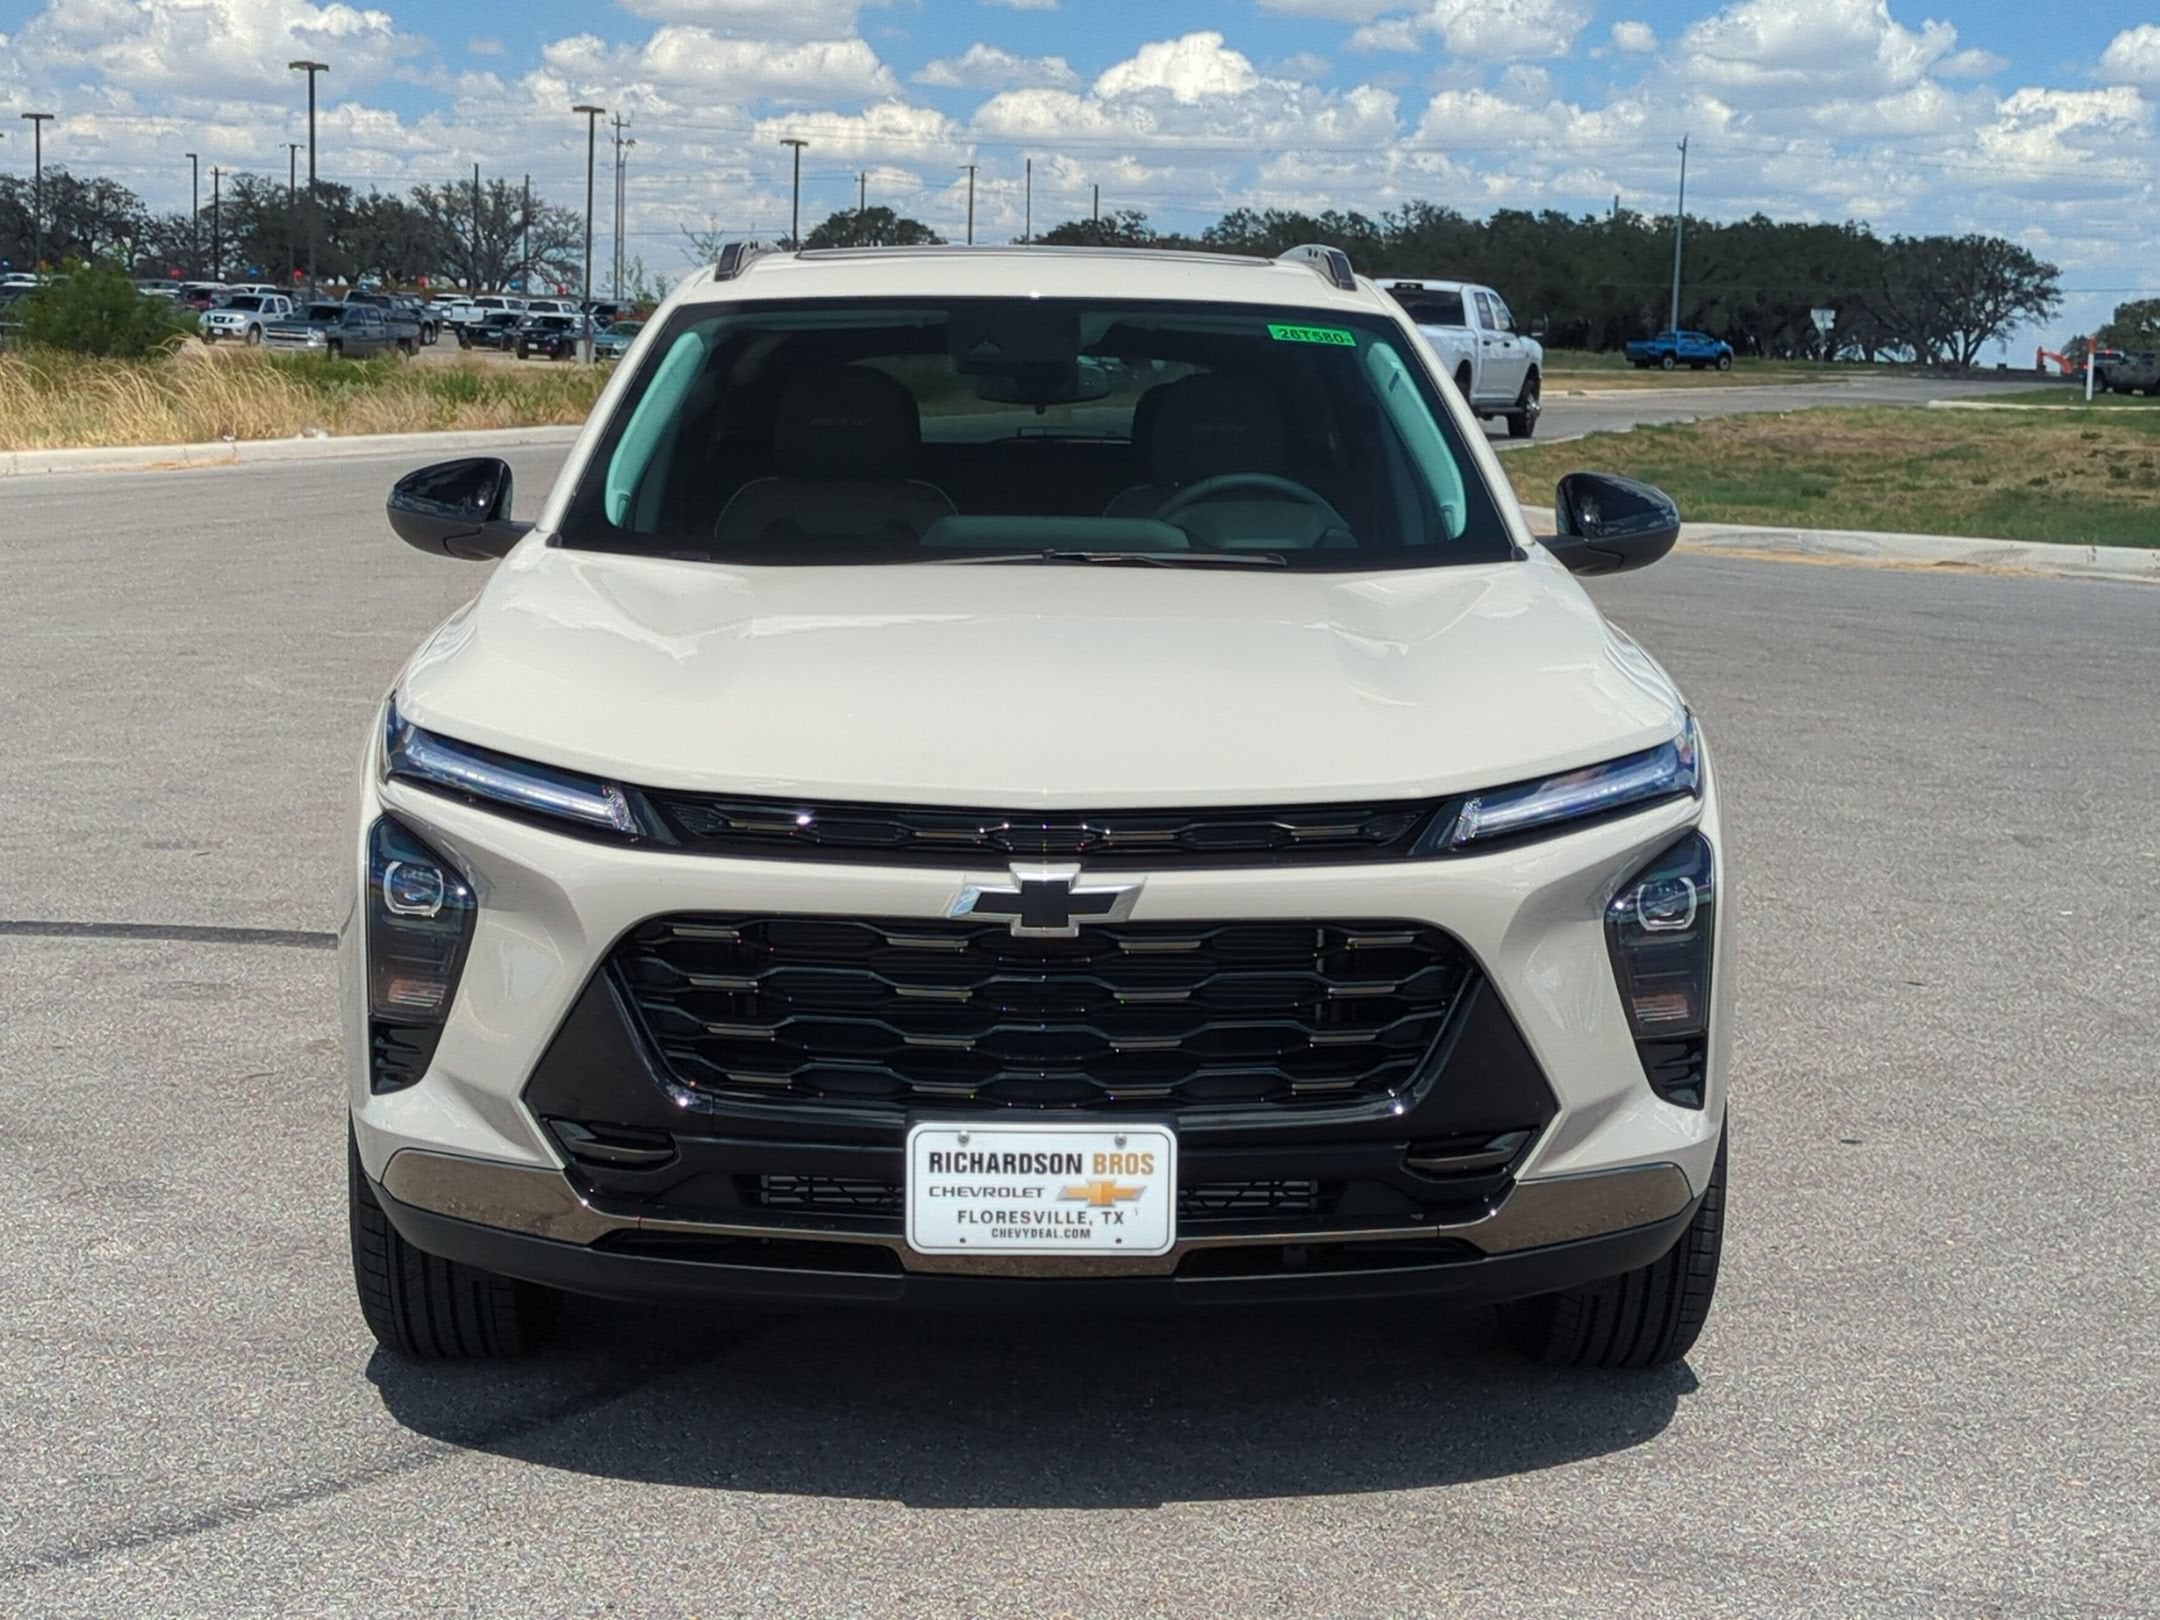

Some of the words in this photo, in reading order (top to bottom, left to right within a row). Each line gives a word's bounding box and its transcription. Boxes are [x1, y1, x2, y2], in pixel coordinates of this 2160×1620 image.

[929, 1152, 1083, 1175] RICHARDSON
[1093, 1153, 1154, 1176] BROS
[929, 1186, 1045, 1198] CHEVROLET
[957, 1210, 1093, 1226] FLORESVILLE,
[1101, 1211, 1125, 1225] TX
[991, 1228, 1091, 1240] CHEVYDEAL.COM
